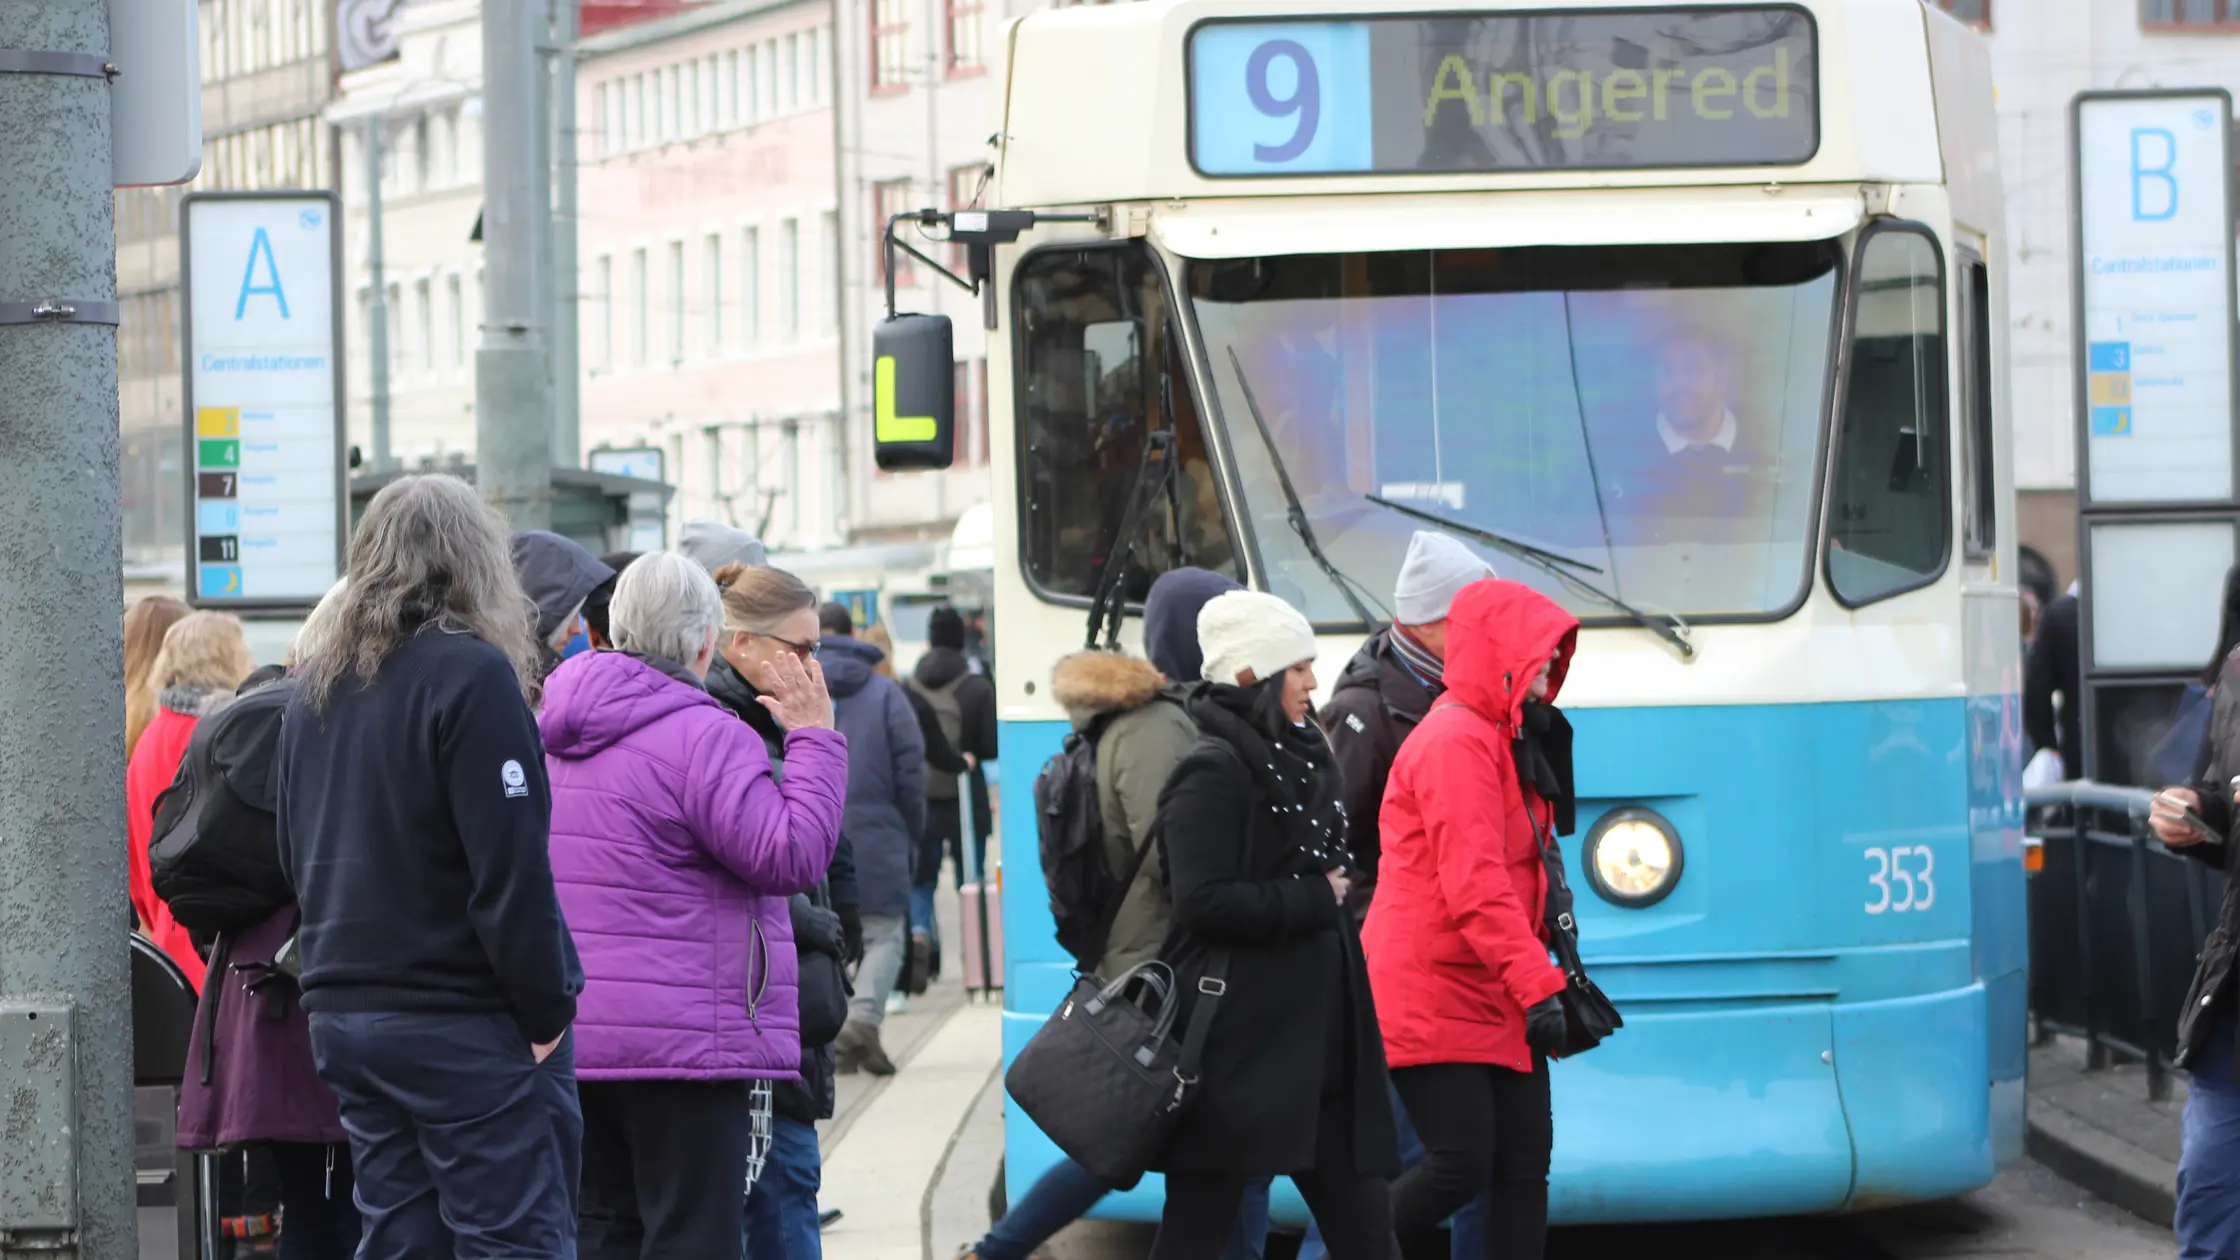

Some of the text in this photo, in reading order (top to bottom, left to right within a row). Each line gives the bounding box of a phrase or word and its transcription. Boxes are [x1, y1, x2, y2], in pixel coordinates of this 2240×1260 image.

[1245, 38, 1791, 164] 9 Angered
[2131, 127, 2179, 222] B
[235, 227, 290, 320] A
[2112, 347, 2126, 368] 3
[224, 413, 235, 432] 2
[223, 443, 235, 463] 4
[222, 475, 233, 496] 7
[220, 540, 235, 560] 11
[1864, 844, 1935, 915] 353
